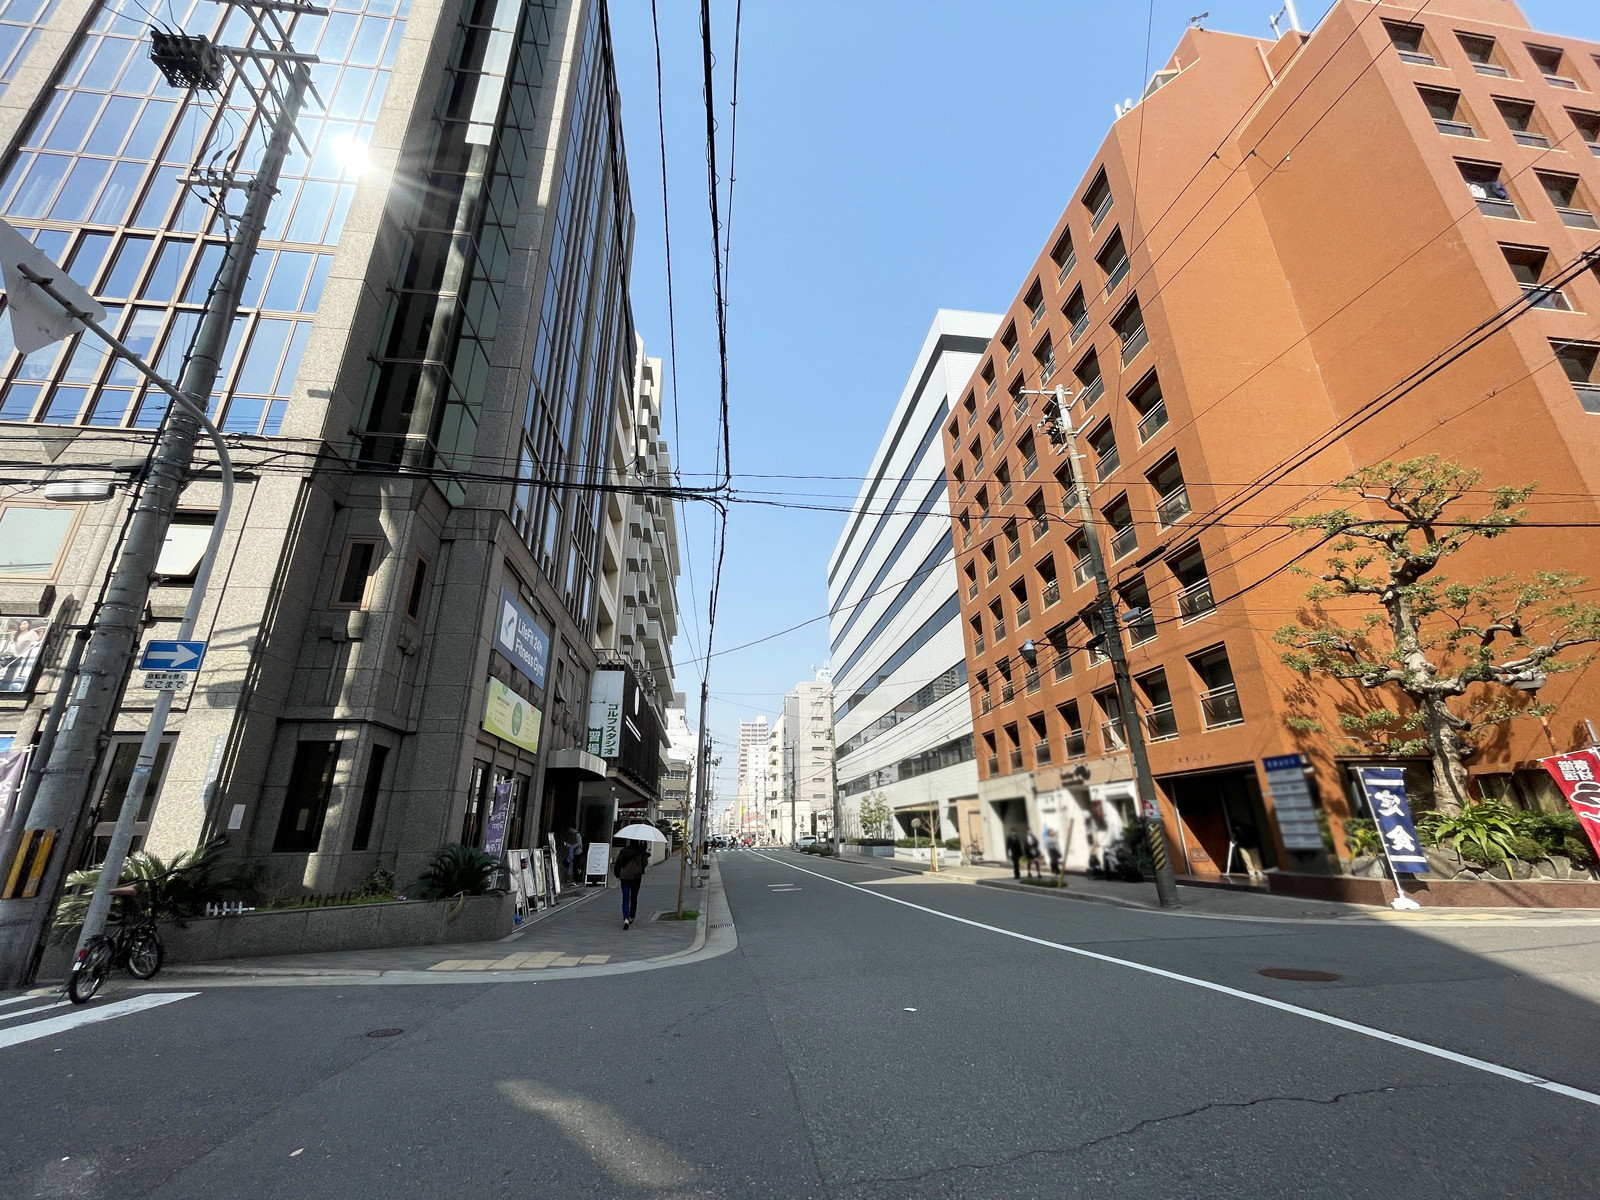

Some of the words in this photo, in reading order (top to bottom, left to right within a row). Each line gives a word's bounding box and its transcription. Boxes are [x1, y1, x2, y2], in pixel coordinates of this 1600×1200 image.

[518, 618, 534, 647] LifeFit
[533, 636, 543, 655] 24h
[515, 638, 533, 667] Fitness
[533, 656, 544, 677] Gym
[144, 680, 184, 689] ここまで
[604, 703, 620, 755] ゴルフスタジオ
[1374, 789, 1416, 852] 定食
